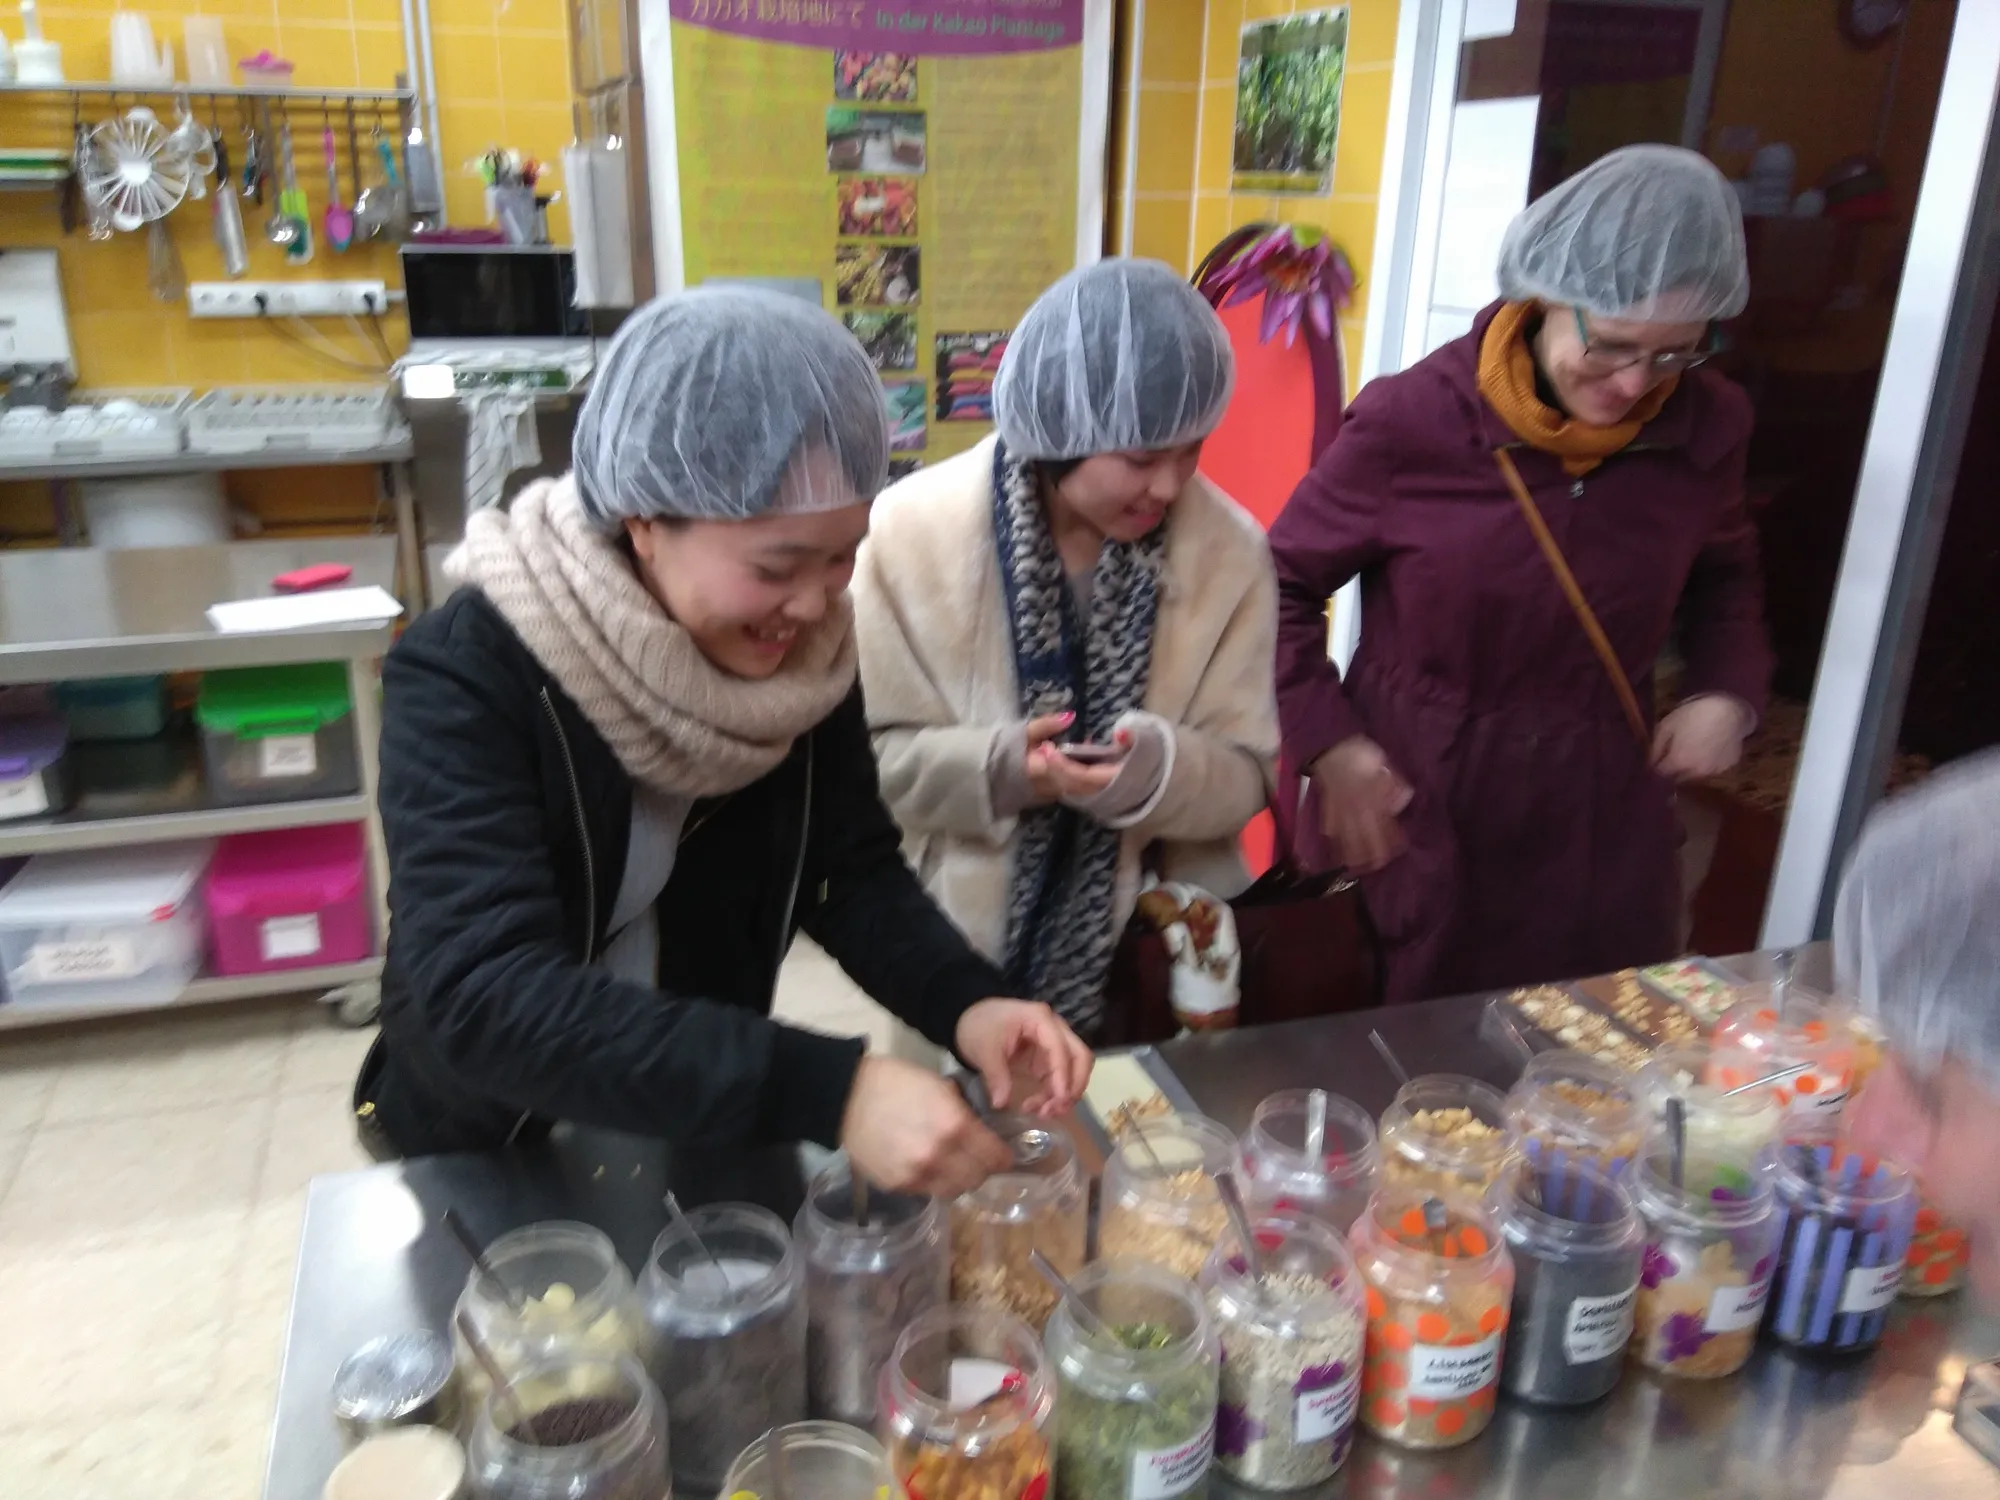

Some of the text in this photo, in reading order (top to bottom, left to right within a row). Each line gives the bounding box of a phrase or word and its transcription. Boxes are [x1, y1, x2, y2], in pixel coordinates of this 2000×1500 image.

[898, 10, 929, 33] der
[932, 10, 988, 36] Kakao
[990, 14, 1066, 43] Plantage
